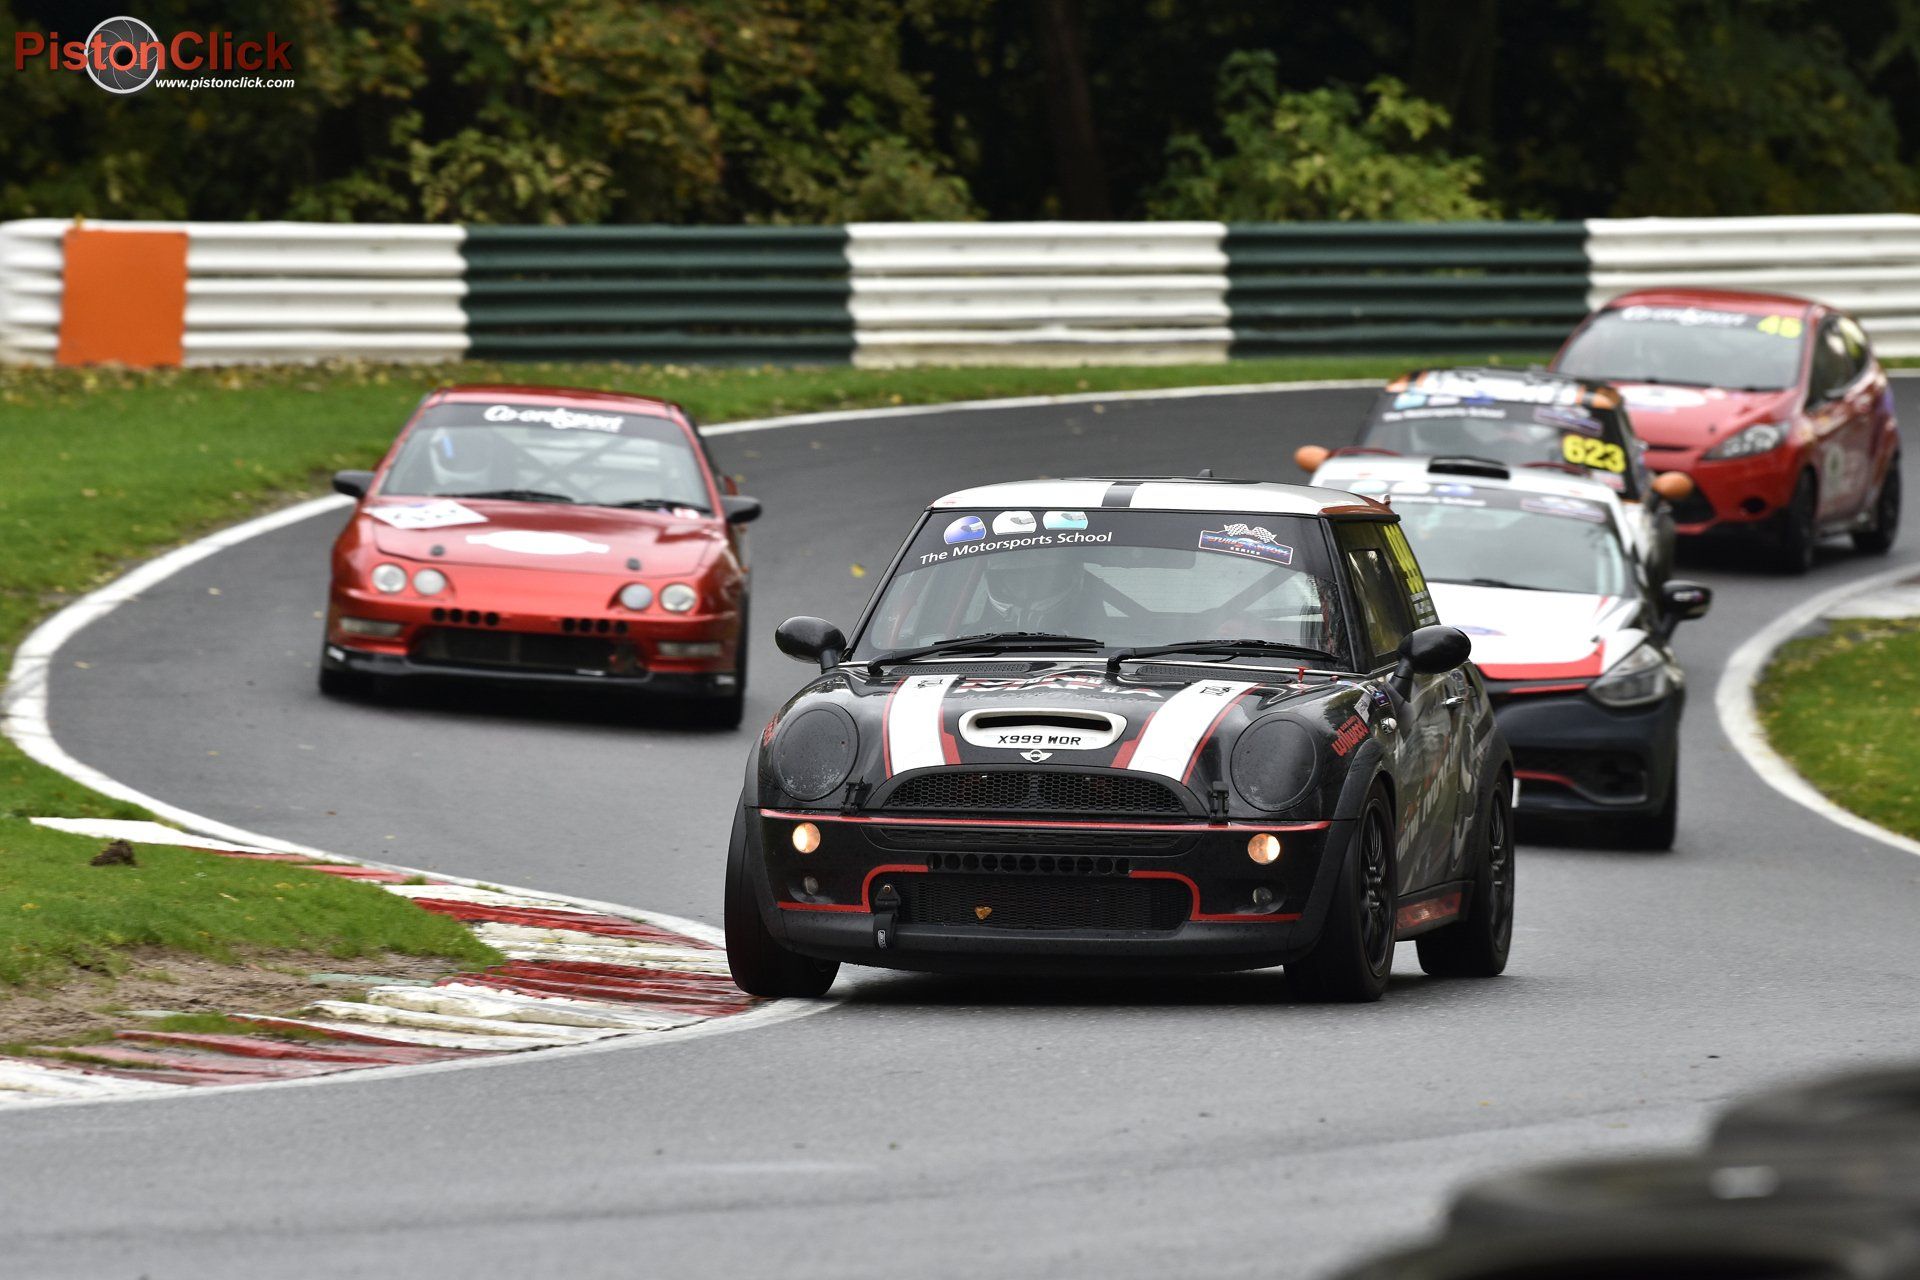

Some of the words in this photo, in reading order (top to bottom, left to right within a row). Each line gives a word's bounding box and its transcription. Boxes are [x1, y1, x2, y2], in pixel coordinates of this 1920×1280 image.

[1562, 433, 1626, 473] 623
[920, 551, 948, 565] The
[953, 534, 1053, 557] Motorsports
[1057, 531, 1112, 543] School
[998, 735, 1043, 744] X999
[1048, 736, 1082, 746] WOR
